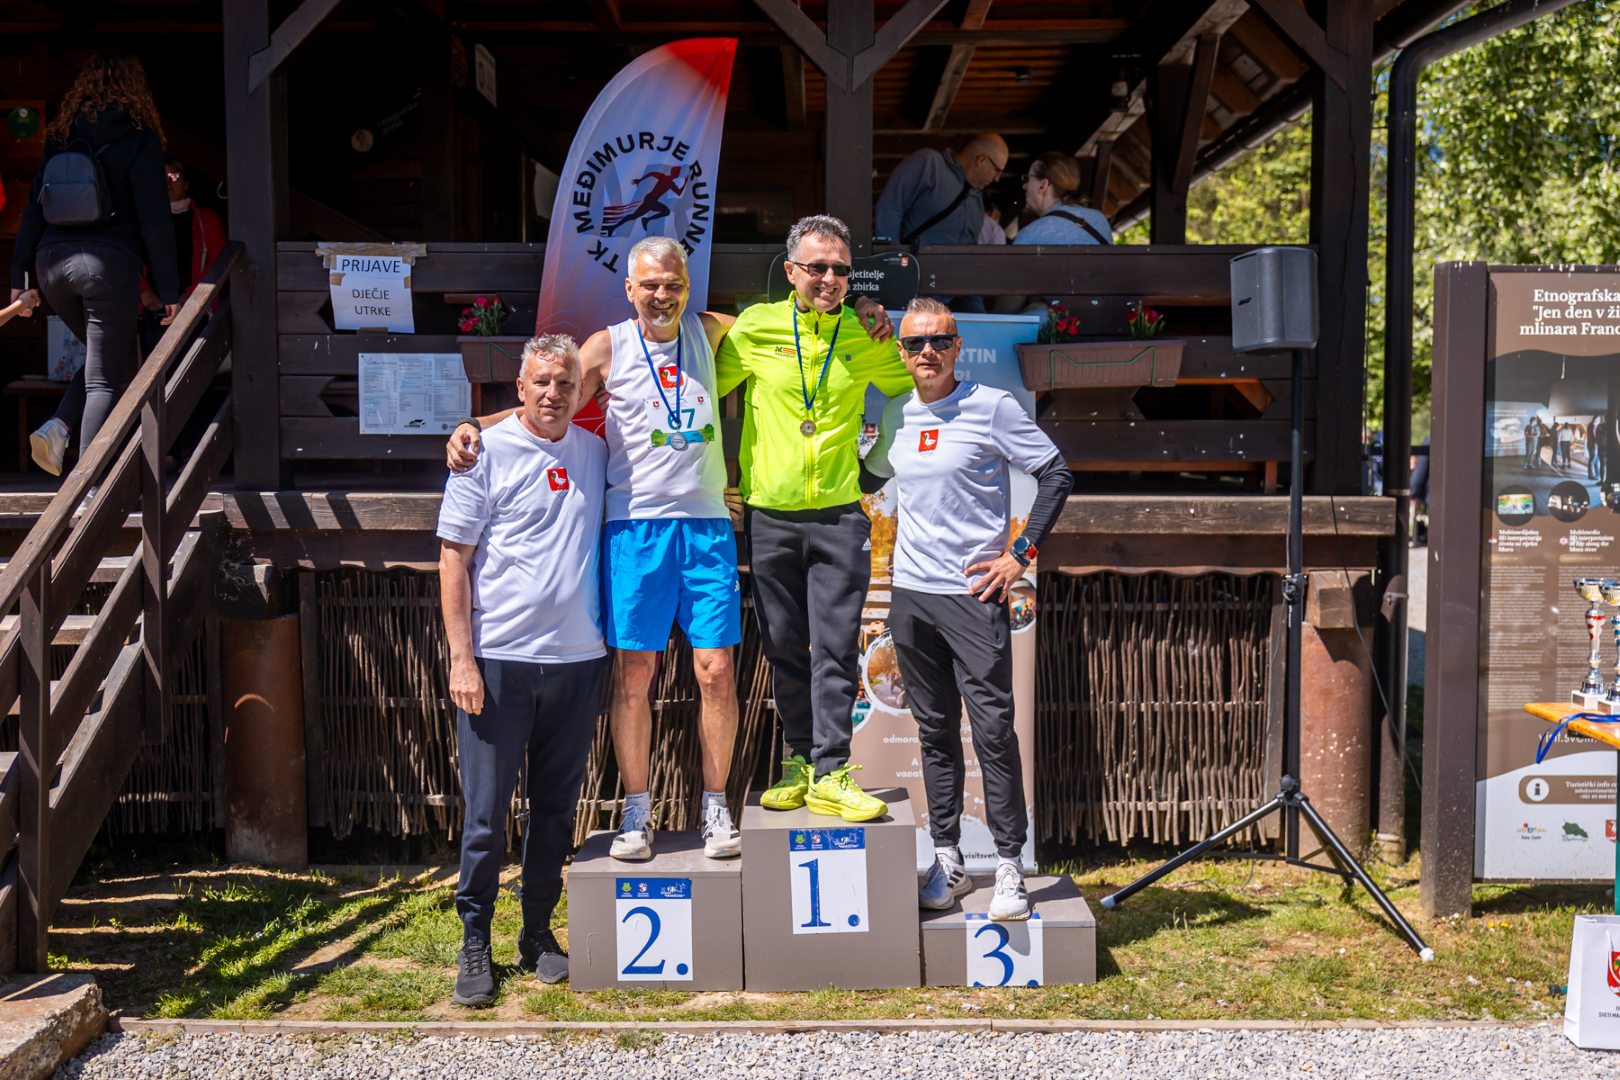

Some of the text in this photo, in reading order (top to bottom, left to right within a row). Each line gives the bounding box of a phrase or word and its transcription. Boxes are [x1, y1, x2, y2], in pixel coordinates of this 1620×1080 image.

[587, 238, 618, 273] TK
[680, 160, 709, 257] RUNNE
[341, 259, 401, 273] PRIJAVE
[848, 270, 885, 280] sjetitelje
[352, 287, 390, 300] DJEČJE
[852, 282, 880, 291] zbirka
[1533, 289, 1620, 305] Etnografska
[354, 305, 391, 316] UTRKE
[1565, 306, 1592, 319] den
[1596, 308, 1604, 319] v
[1607, 305, 1620, 319] ži
[1519, 322, 1620, 335] mlinara Franc
[667, 408, 695, 430] 67
[896, 768, 923, 778] vacat
[798, 858, 860, 928] 1.
[621, 906, 689, 976] 2.
